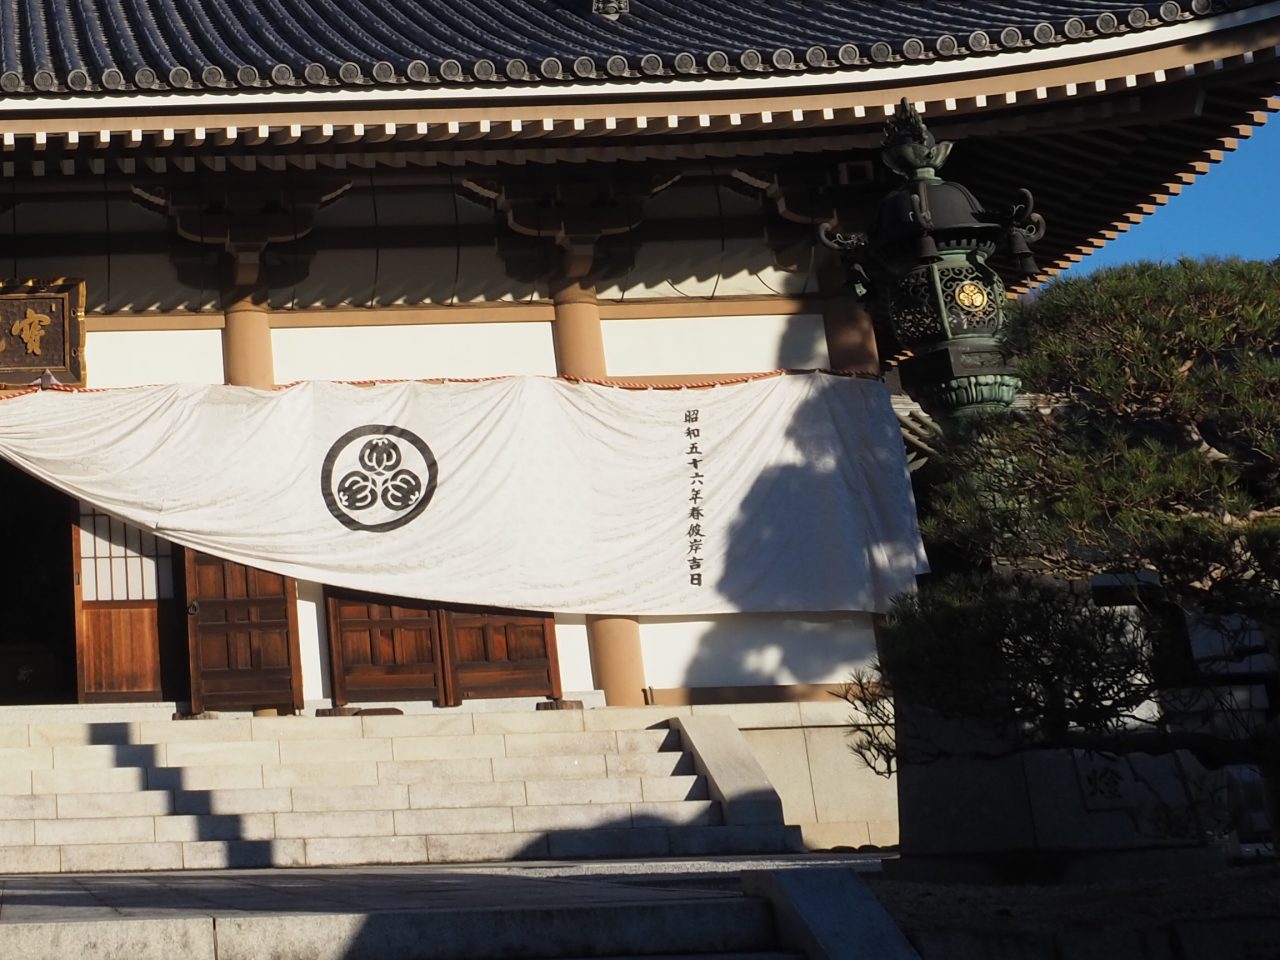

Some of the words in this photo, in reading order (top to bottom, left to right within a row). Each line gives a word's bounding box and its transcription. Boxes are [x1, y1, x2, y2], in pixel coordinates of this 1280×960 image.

[683, 409, 706, 587] 昭和五十六年春彼岸吉日
